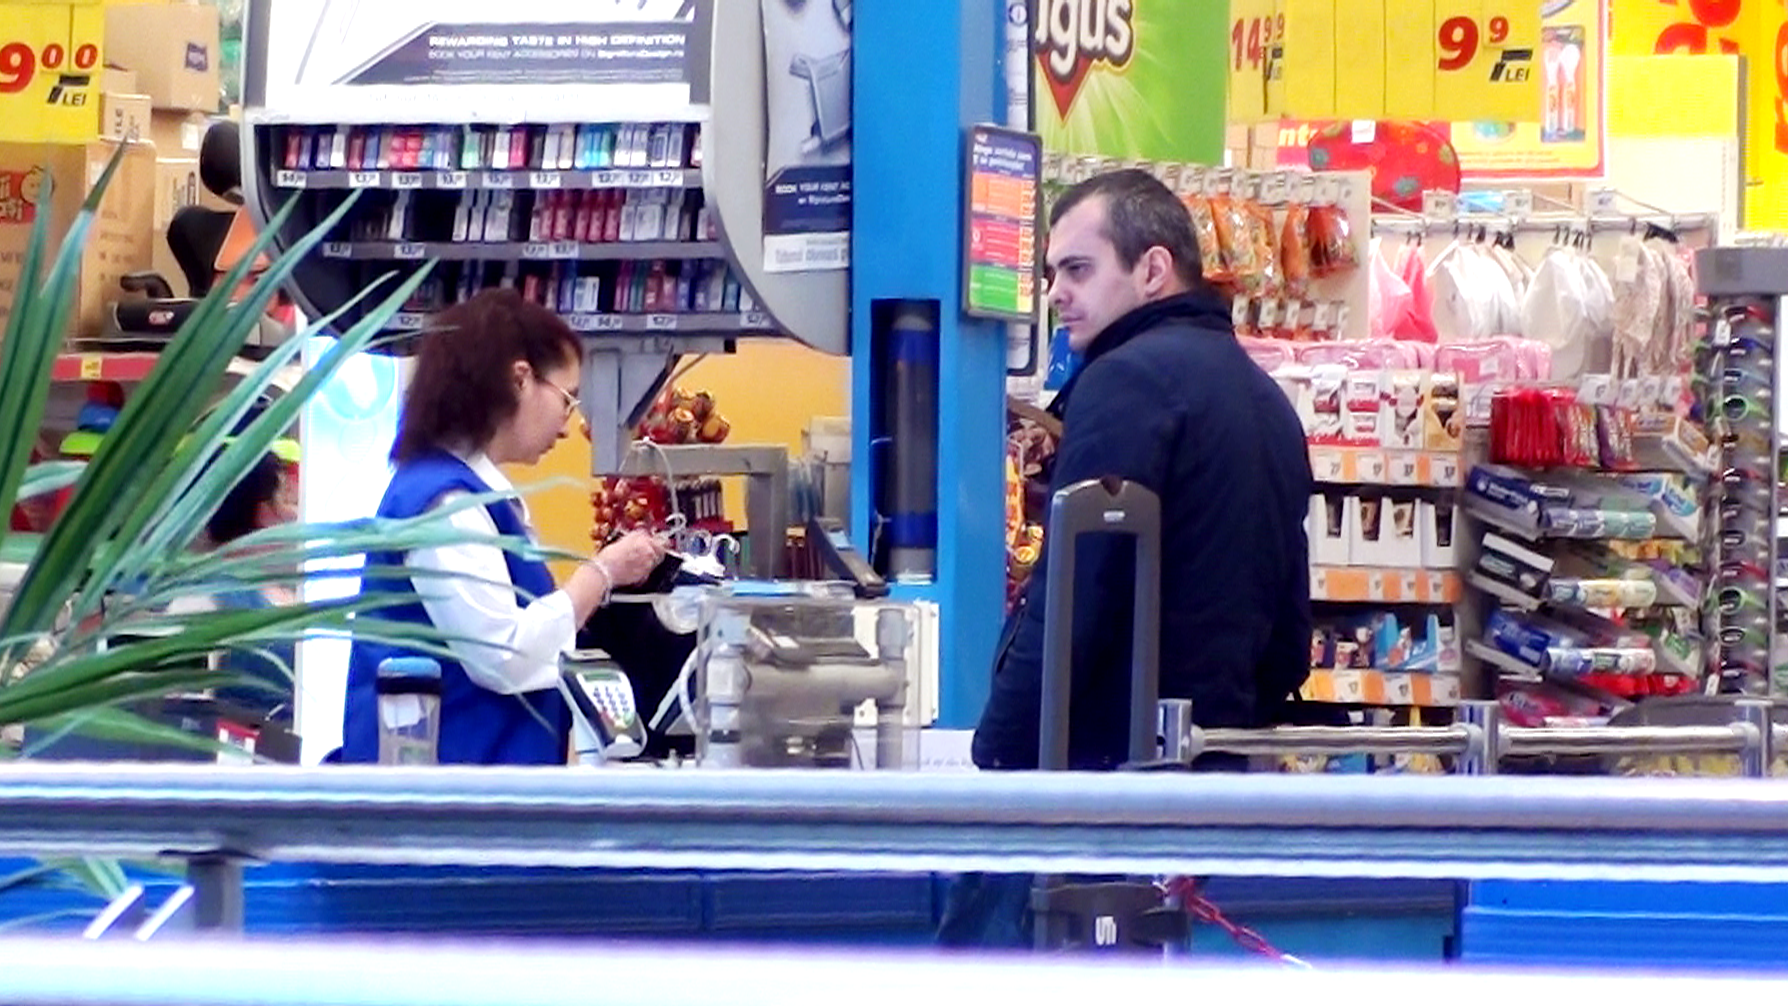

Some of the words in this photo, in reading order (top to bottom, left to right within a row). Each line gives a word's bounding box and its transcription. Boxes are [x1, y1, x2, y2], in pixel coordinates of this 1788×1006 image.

[428, 34, 508, 47] REWARDING
[512, 34, 554, 46] TASTE
[557, 35, 572, 46] IN
[575, 35, 608, 46] HIGH
[610, 34, 686, 45] DEFINITION
[457, 50, 484, 59] YOUR
[1505, 67, 1531, 83] LEI
[62, 92, 87, 107] LEI
